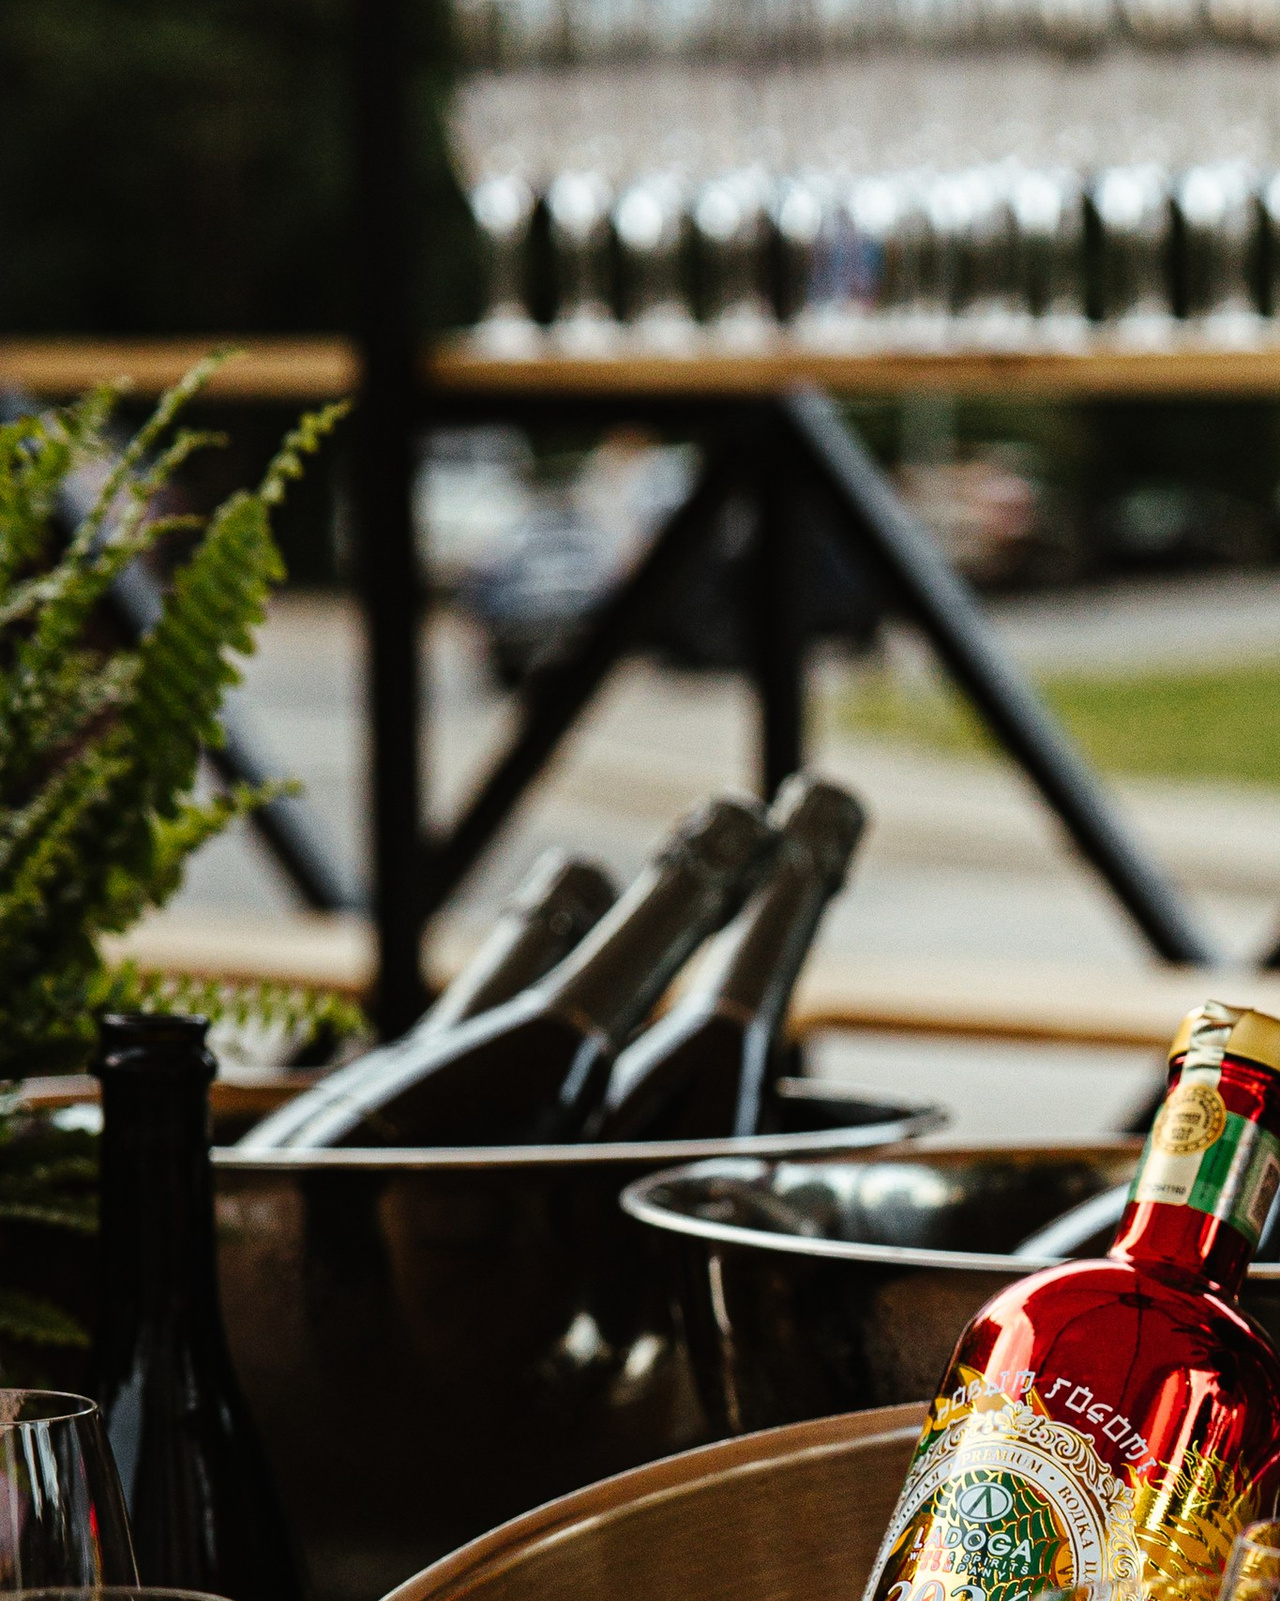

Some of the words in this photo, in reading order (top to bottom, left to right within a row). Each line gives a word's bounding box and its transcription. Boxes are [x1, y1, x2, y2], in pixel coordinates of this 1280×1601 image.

[959, 1449, 1044, 1476] PREMIUM
[1057, 1486, 1095, 1550] ВОДКА
[913, 1525, 1032, 1564] LADOGA
[920, 1559, 1006, 1580] COMPANY
[962, 1553, 1030, 1576] SPIRITS
